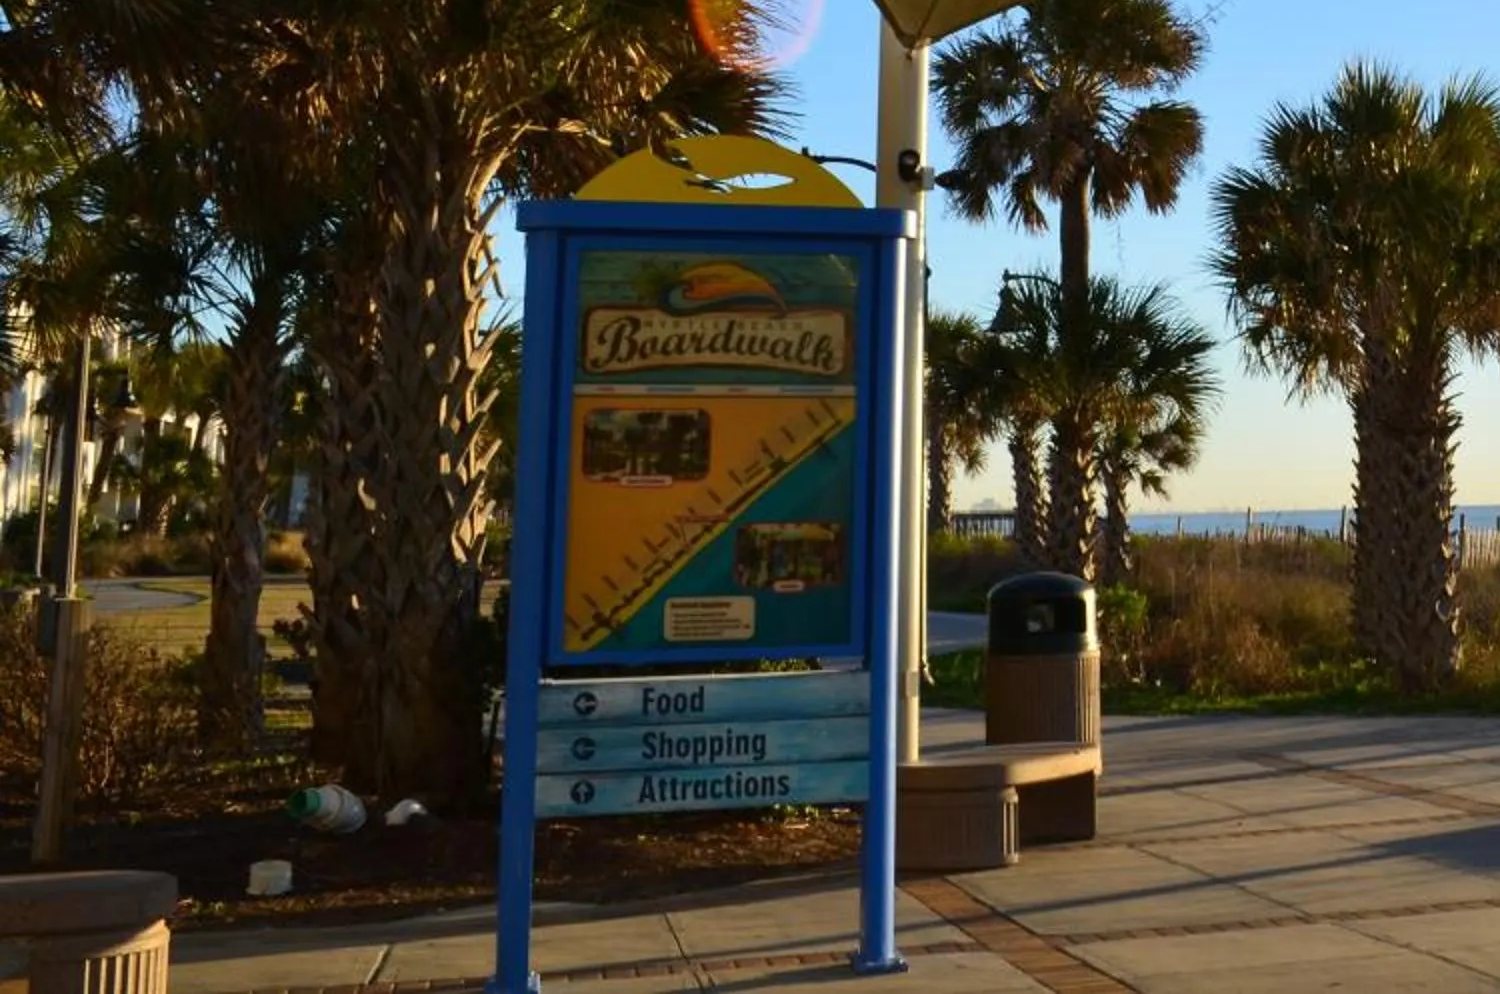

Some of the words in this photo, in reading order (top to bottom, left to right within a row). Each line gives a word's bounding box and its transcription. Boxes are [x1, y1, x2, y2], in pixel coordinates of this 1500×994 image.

[590, 316, 836, 371] Boardwalk
[641, 686, 705, 716] Food
[641, 728, 767, 764] Shopping
[638, 771, 790, 804] Attractions
